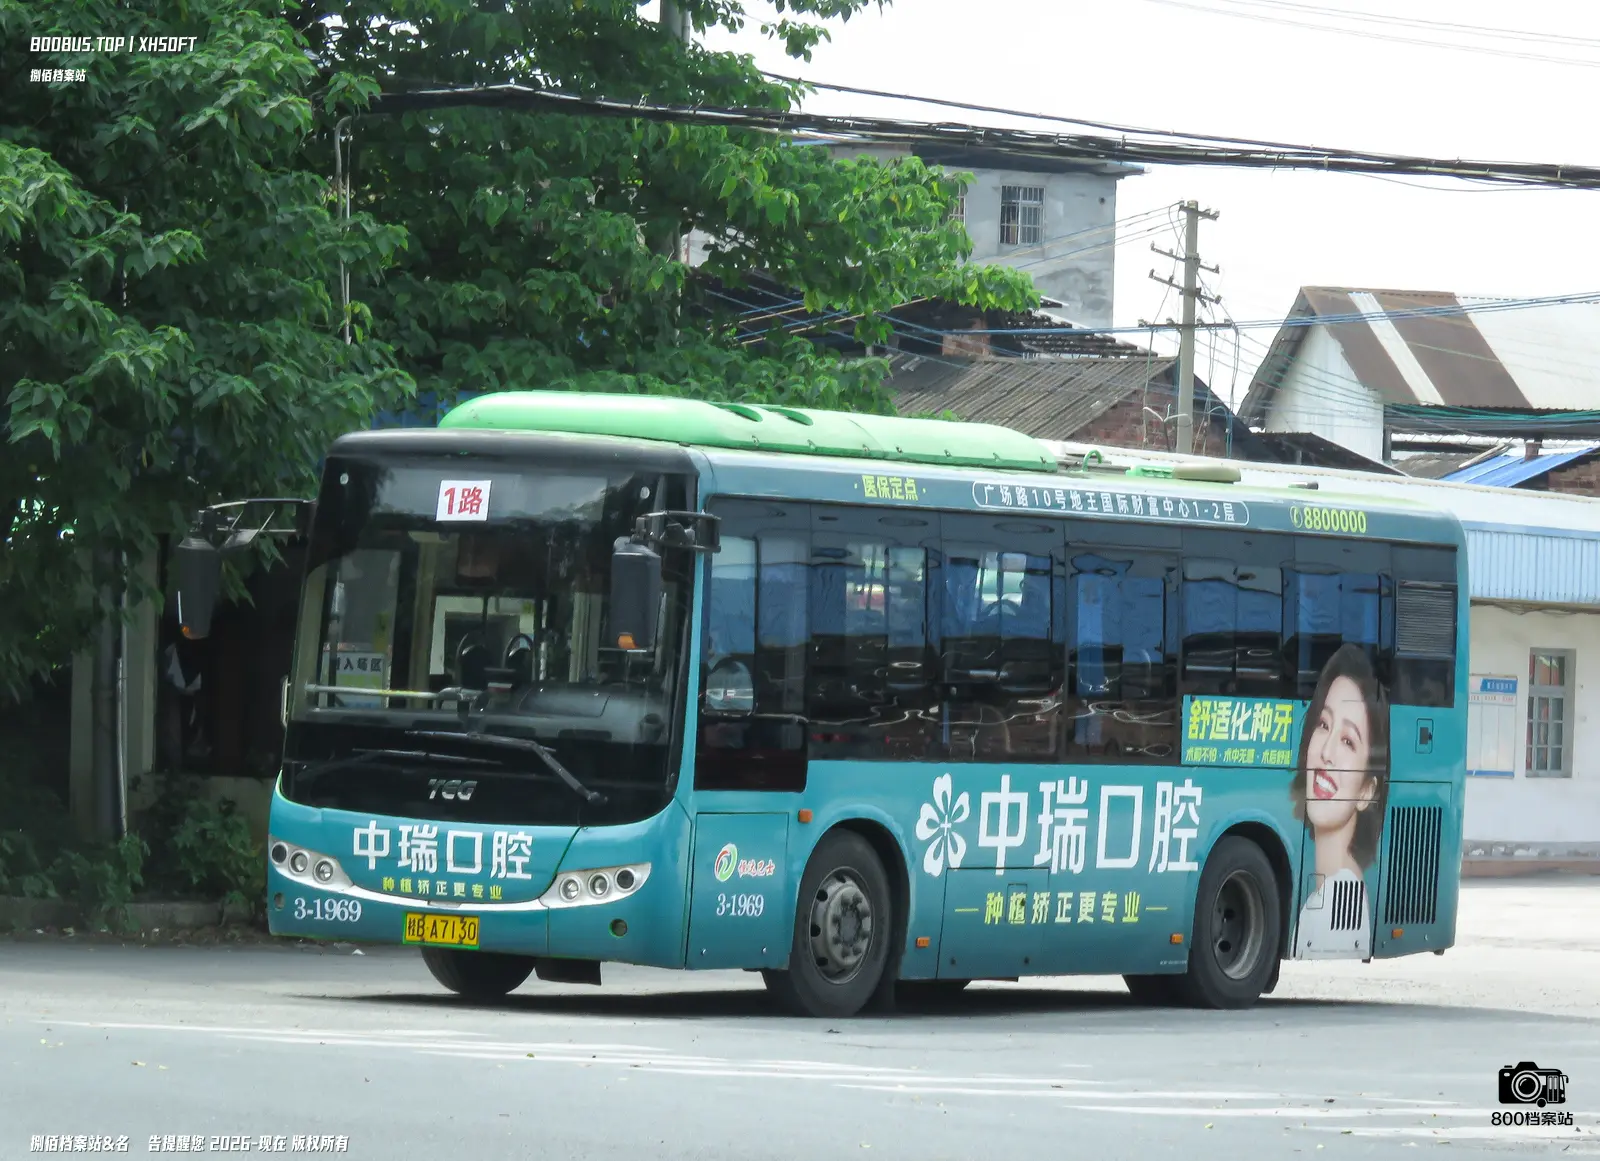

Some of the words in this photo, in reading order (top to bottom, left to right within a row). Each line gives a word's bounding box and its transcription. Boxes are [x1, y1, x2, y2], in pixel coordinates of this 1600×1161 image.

[444, 486, 483, 515] 1路
[861, 474, 919, 501] 医保定点
[983, 484, 1236, 522] 广场路10号地王国际财富中心1-2层
[1303, 505, 1368, 533] 8800000
[1187, 699, 1293, 743] 舒适化种牙
[978, 774, 1203, 876] 中瑞口腔
[353, 819, 534, 880] 中瑞口腔
[382, 876, 503, 900] 种植矫正更专业
[294, 897, 362, 923] 3-1969
[716, 893, 764, 917] 3-1969
[984, 891, 1141, 925] 种植矫正更专业
